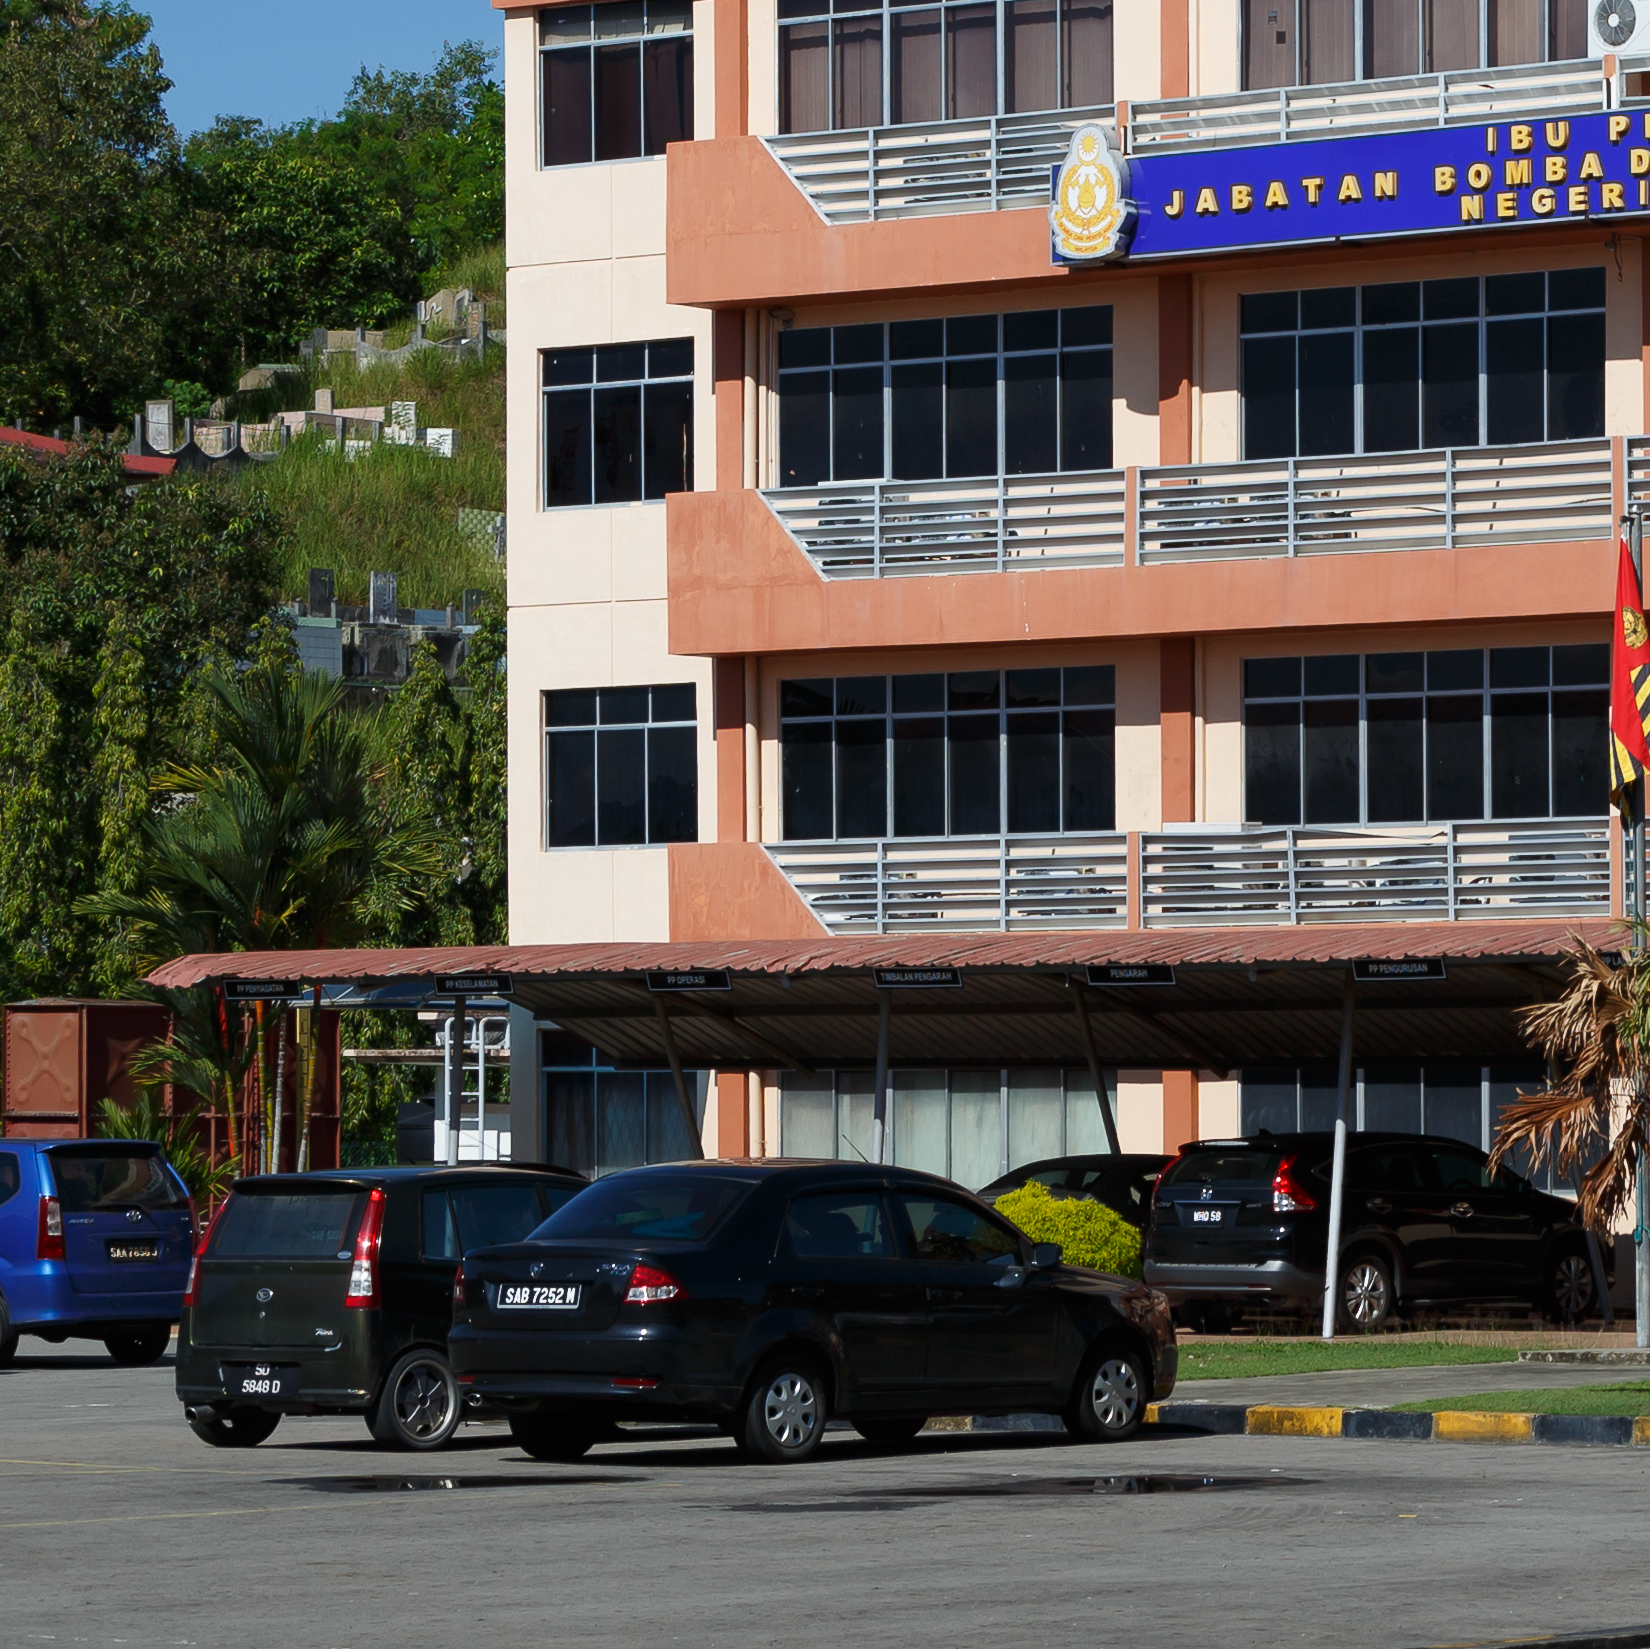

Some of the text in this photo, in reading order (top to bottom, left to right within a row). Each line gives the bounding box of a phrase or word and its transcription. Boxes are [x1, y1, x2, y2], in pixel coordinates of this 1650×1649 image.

[1486, 121, 1571, 153] IBU
[1164, 171, 1398, 217] JABATAN
[1433, 152, 1604, 193] BOMBA
[1460, 179, 1650, 222] NEGERI
[1368, 963, 1429, 973] PP PENGURUSAN
[667, 975, 676, 984] PP
[505, 1287, 576, 1304] SAB 7252 M
[241, 1380, 281, 1394] 5848 D
